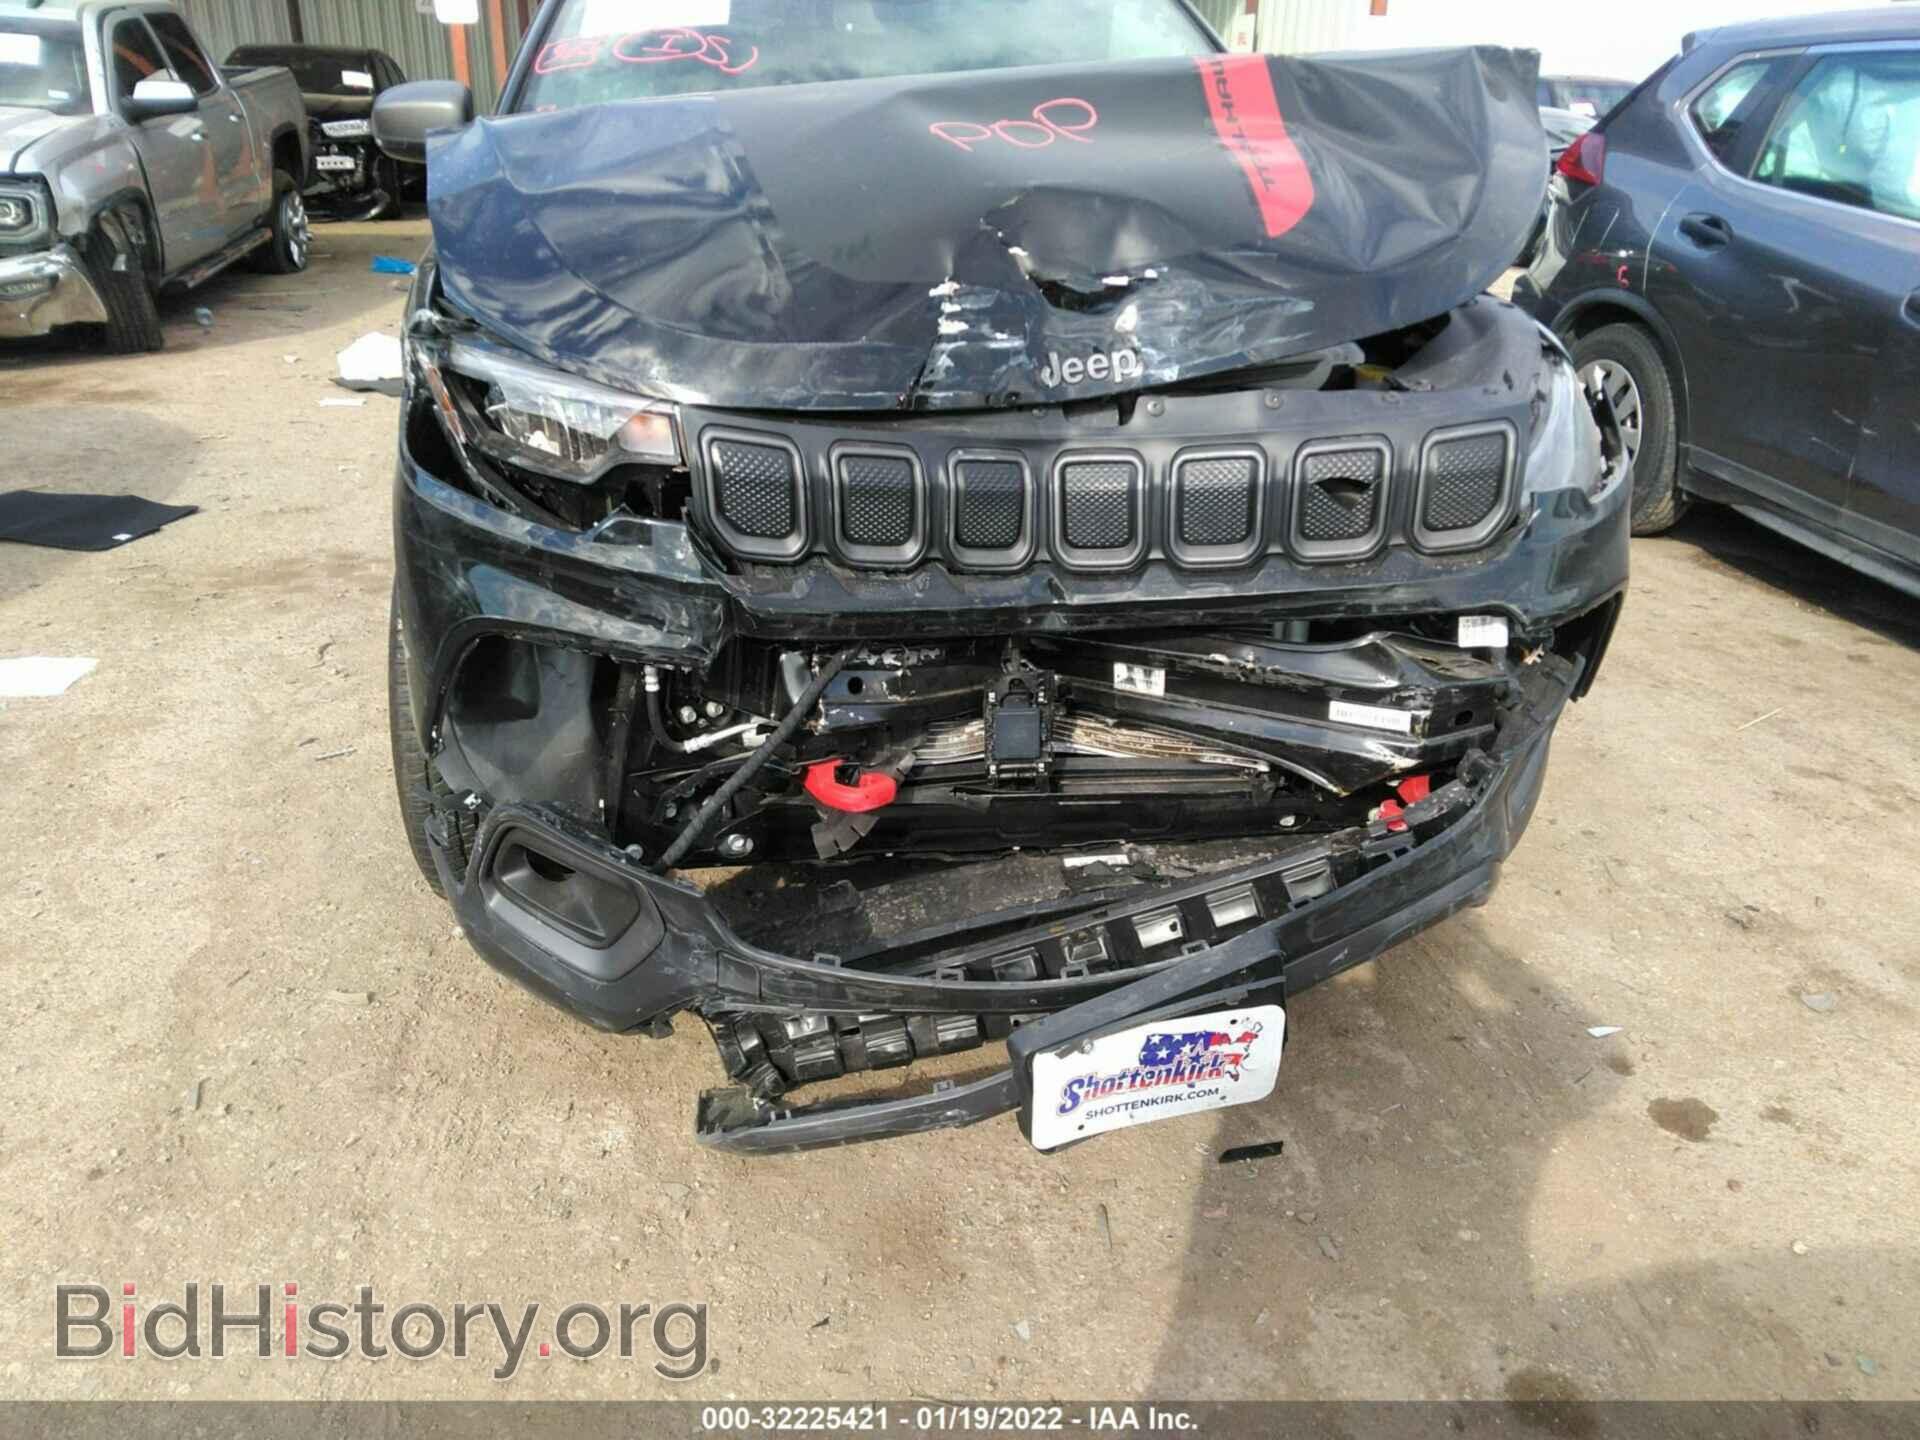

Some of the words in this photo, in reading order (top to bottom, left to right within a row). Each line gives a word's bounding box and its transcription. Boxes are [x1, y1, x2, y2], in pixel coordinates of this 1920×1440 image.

[1040, 349, 1139, 388] Jeep
[1057, 1054, 1225, 1116] Shottenkirk
[1085, 1087, 1219, 1120] SHOTTENKIRK.COM
